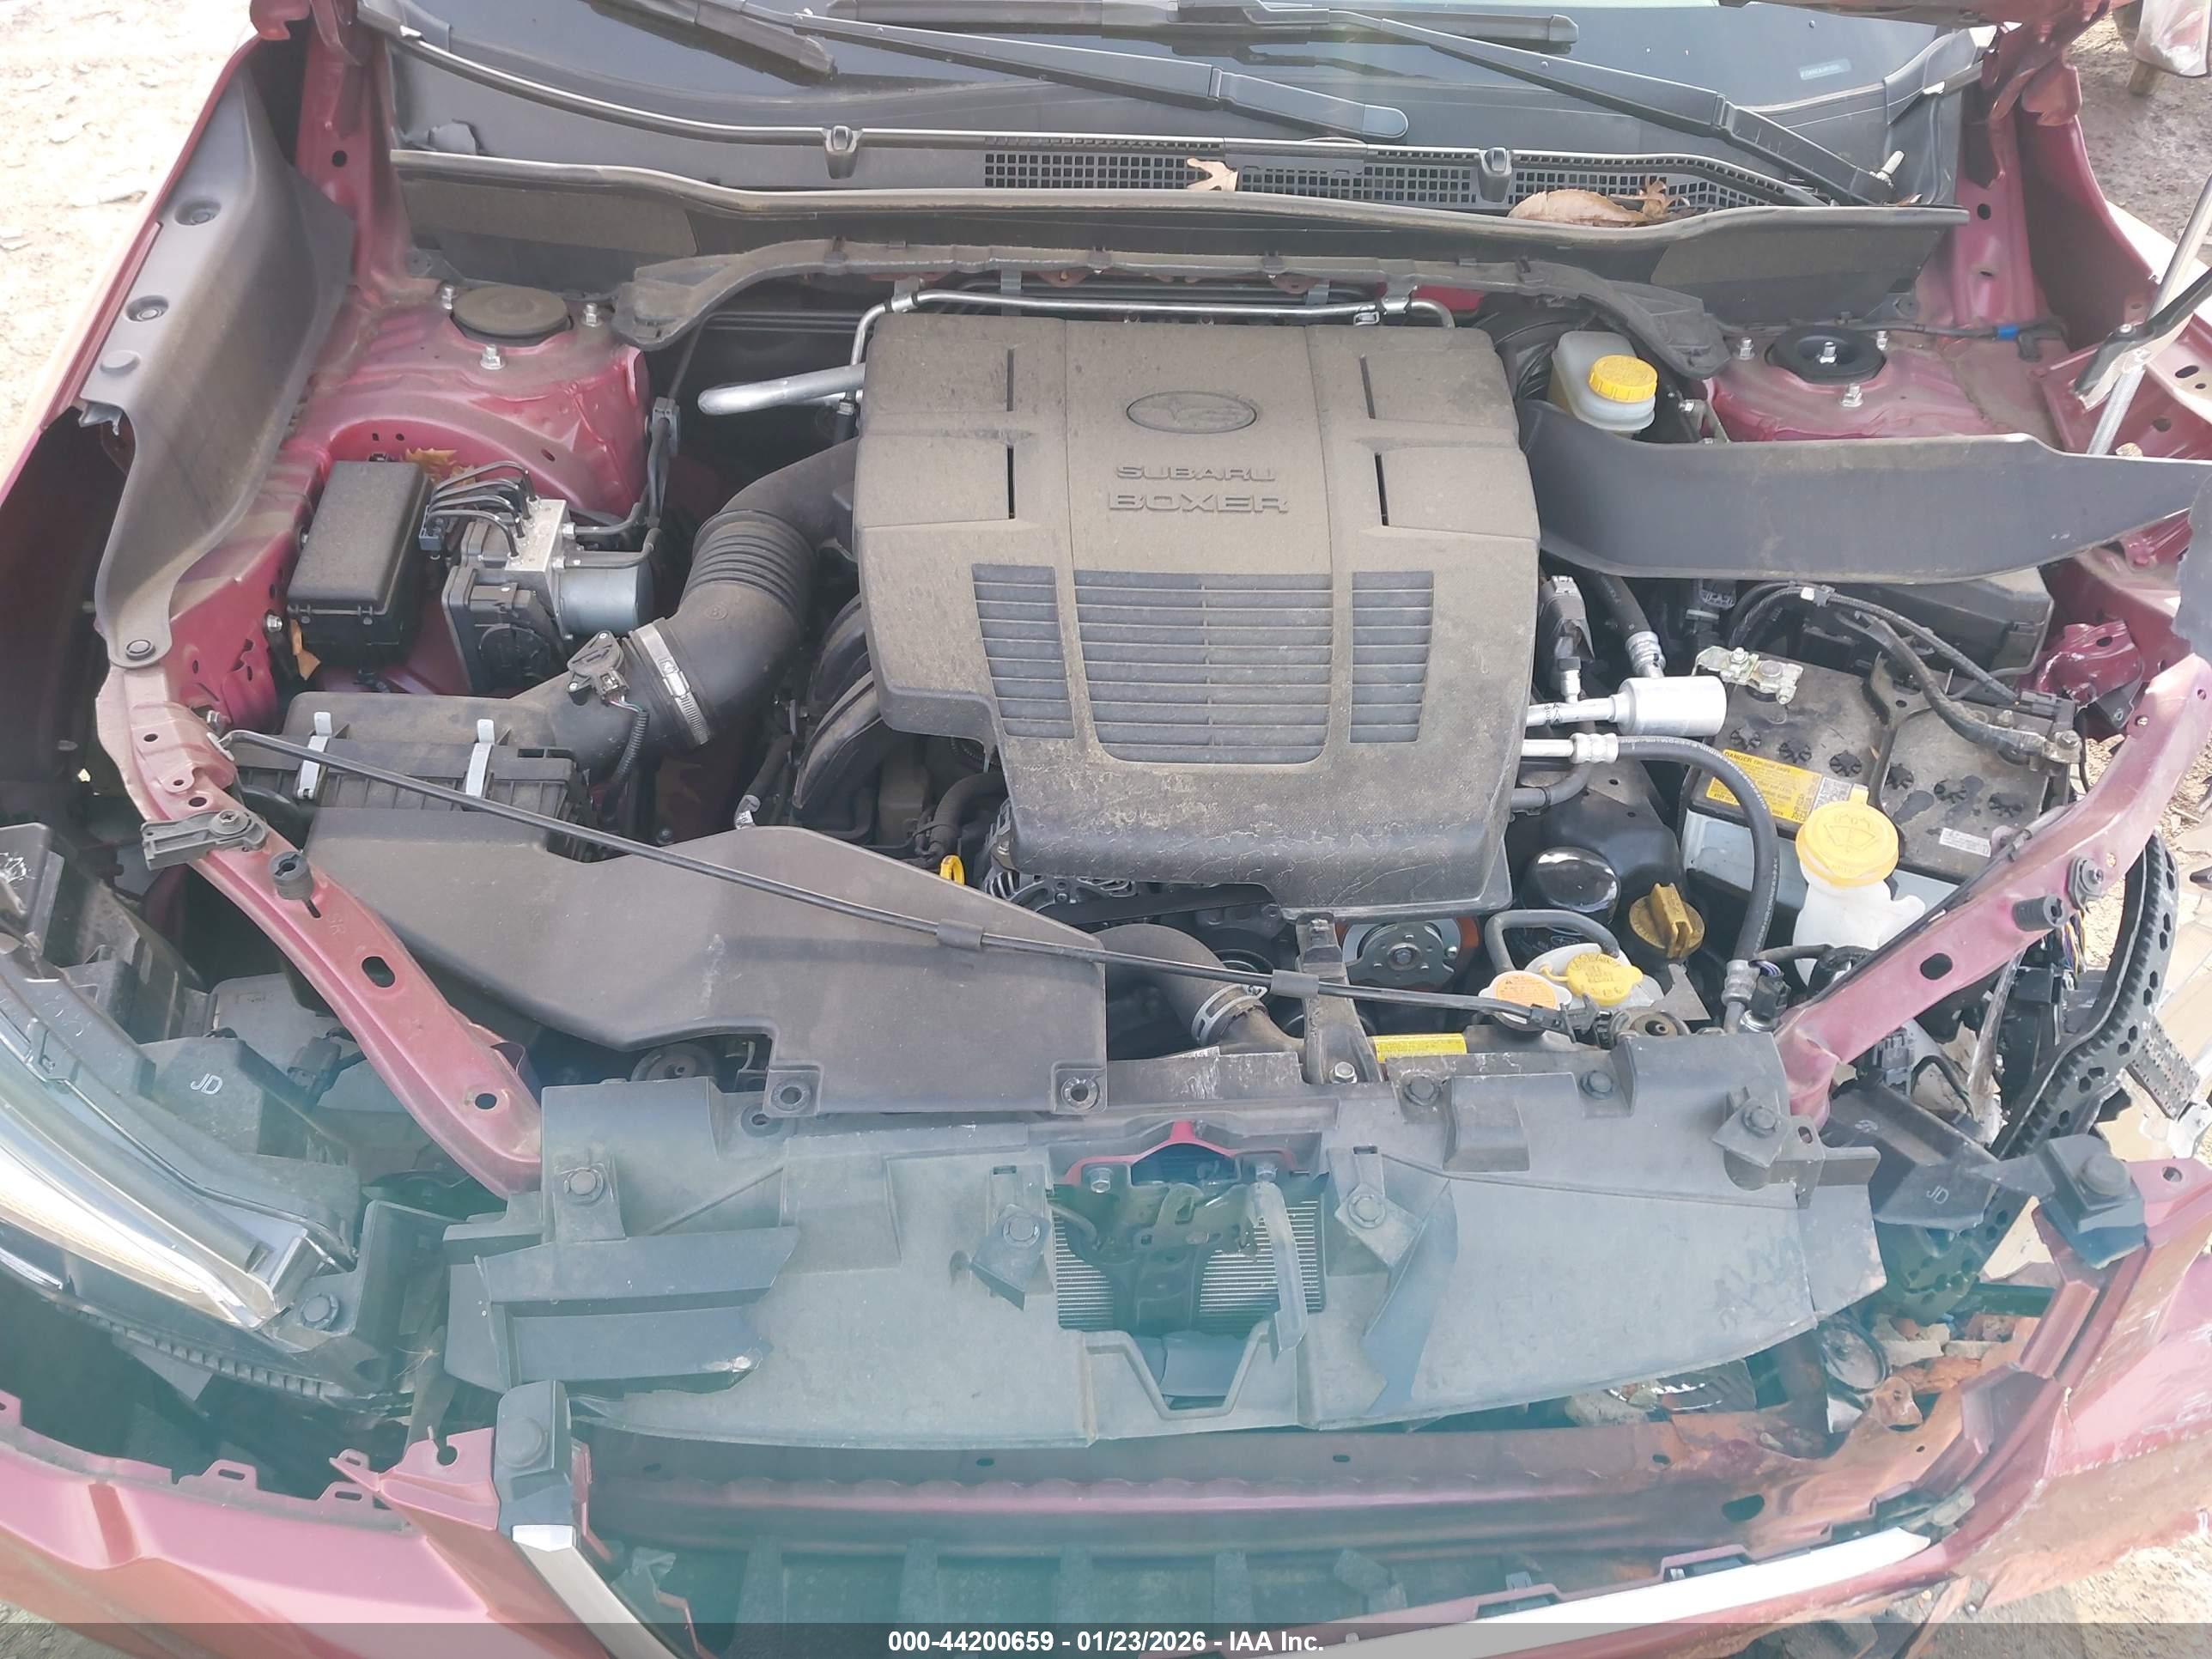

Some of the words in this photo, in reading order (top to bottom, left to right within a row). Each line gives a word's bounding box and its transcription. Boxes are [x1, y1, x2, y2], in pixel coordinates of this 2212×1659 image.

[1115, 465, 1277, 482] SUBARU
[1109, 491, 1289, 513] BOXER
[191, 1073, 223, 1095] JD
[1926, 1184, 1949, 1204] JD
